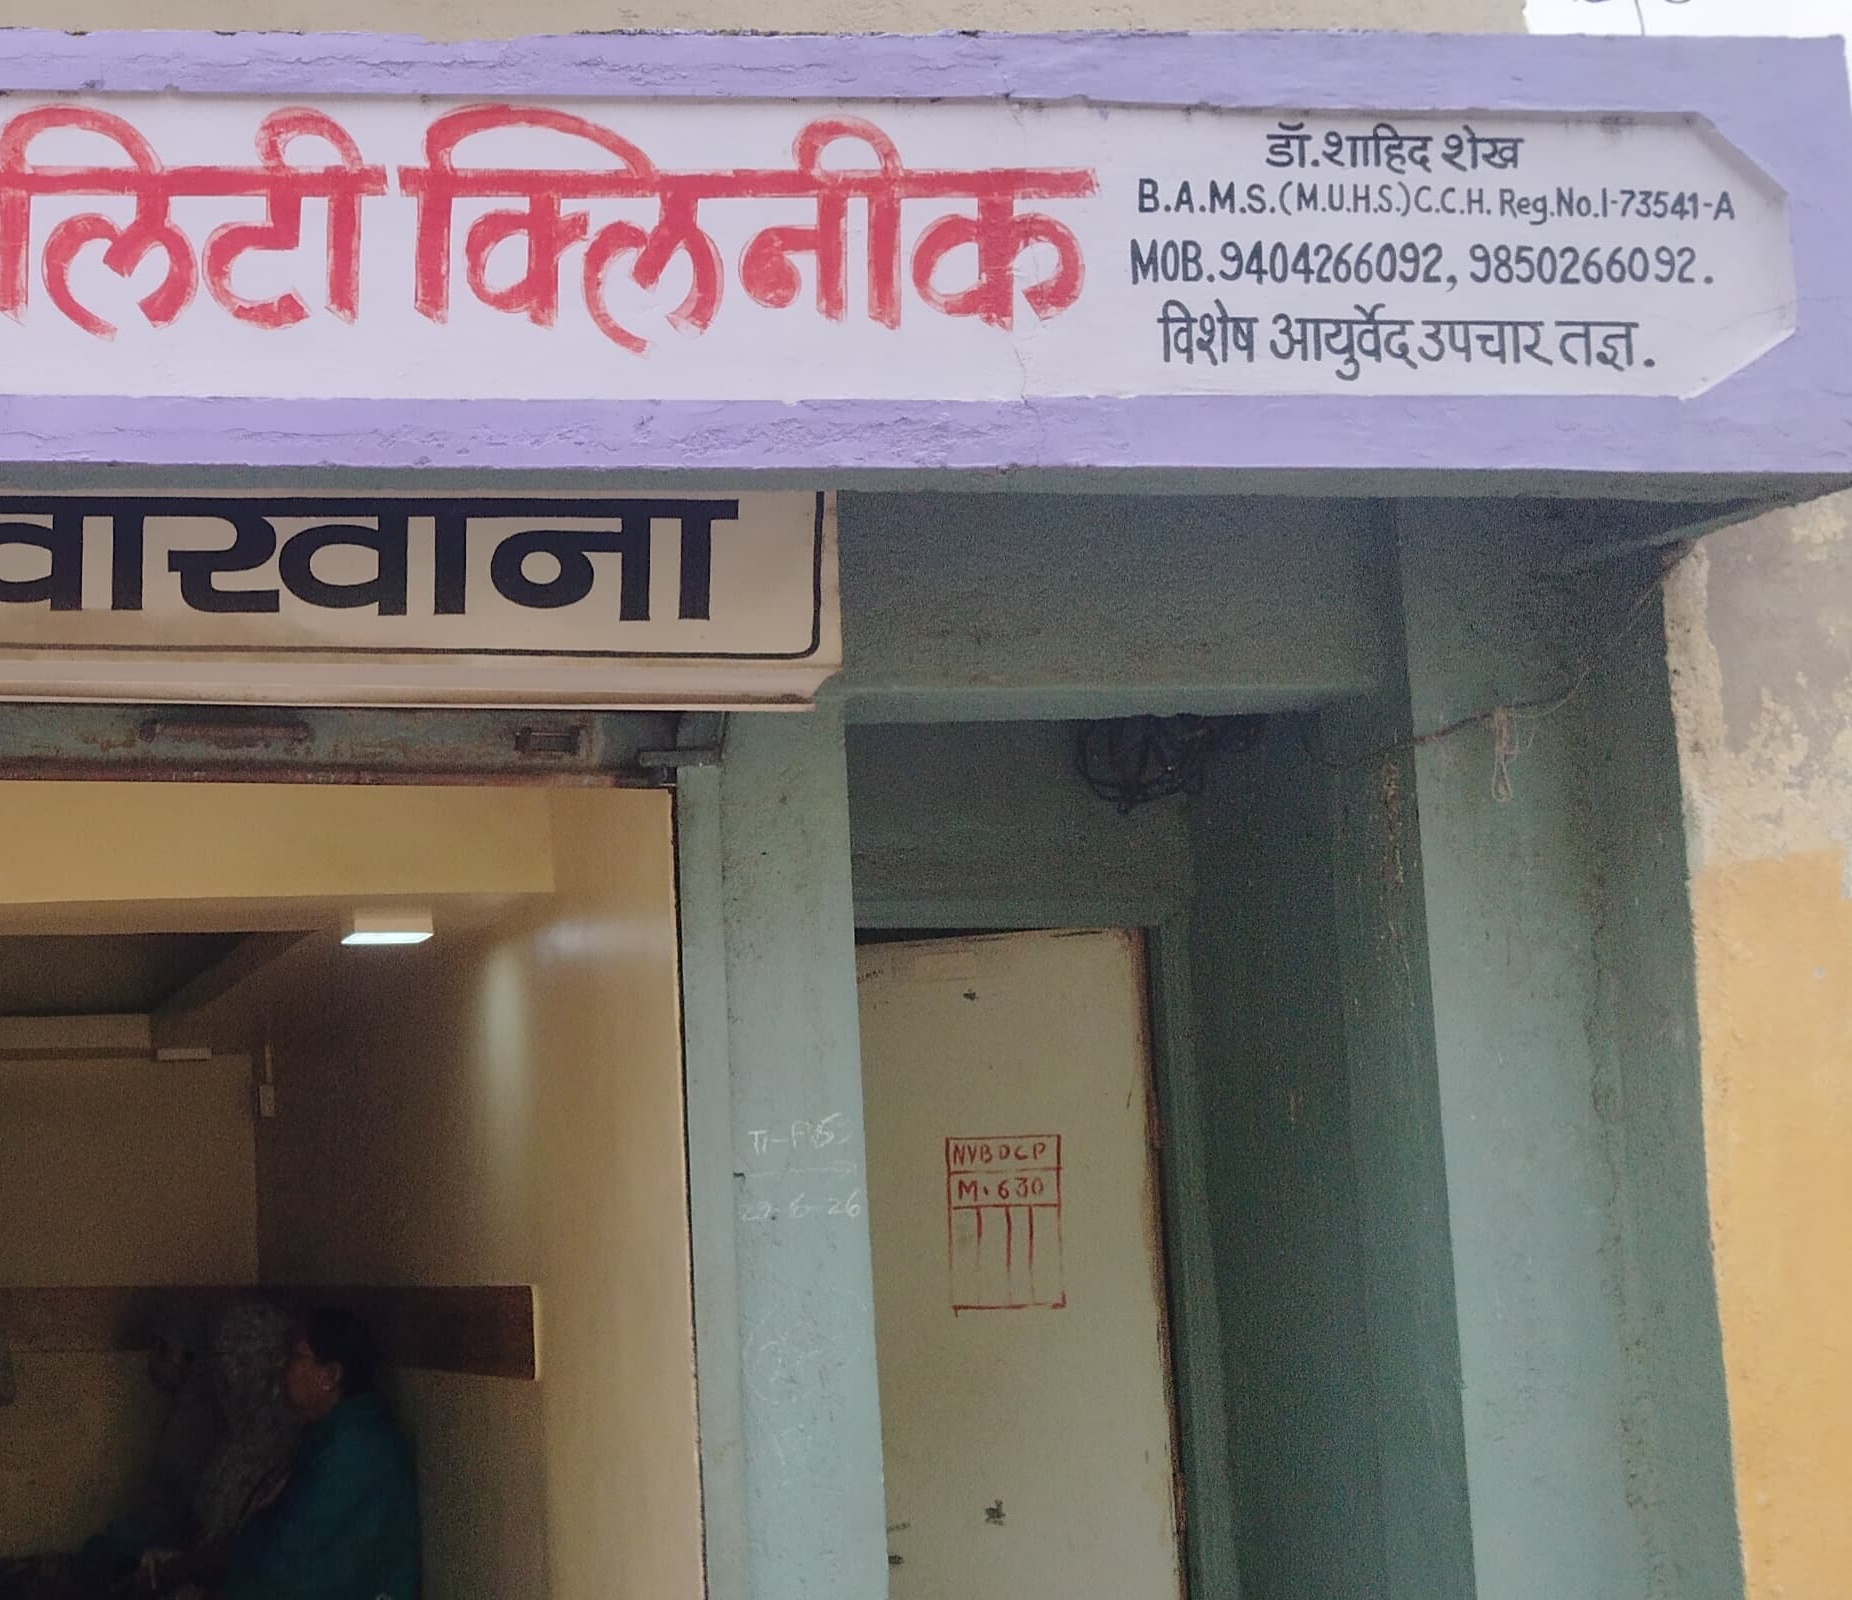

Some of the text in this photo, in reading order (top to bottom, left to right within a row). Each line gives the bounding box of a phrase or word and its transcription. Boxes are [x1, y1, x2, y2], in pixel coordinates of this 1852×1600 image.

[1441, 124, 1525, 172] शेख
[396, 103, 1098, 358] क्लिनीक
[1157, 298, 1259, 366] विशेष
[1269, 303, 1418, 381] आयुर्वेद
[1417, 320, 1553, 366] उपचार
